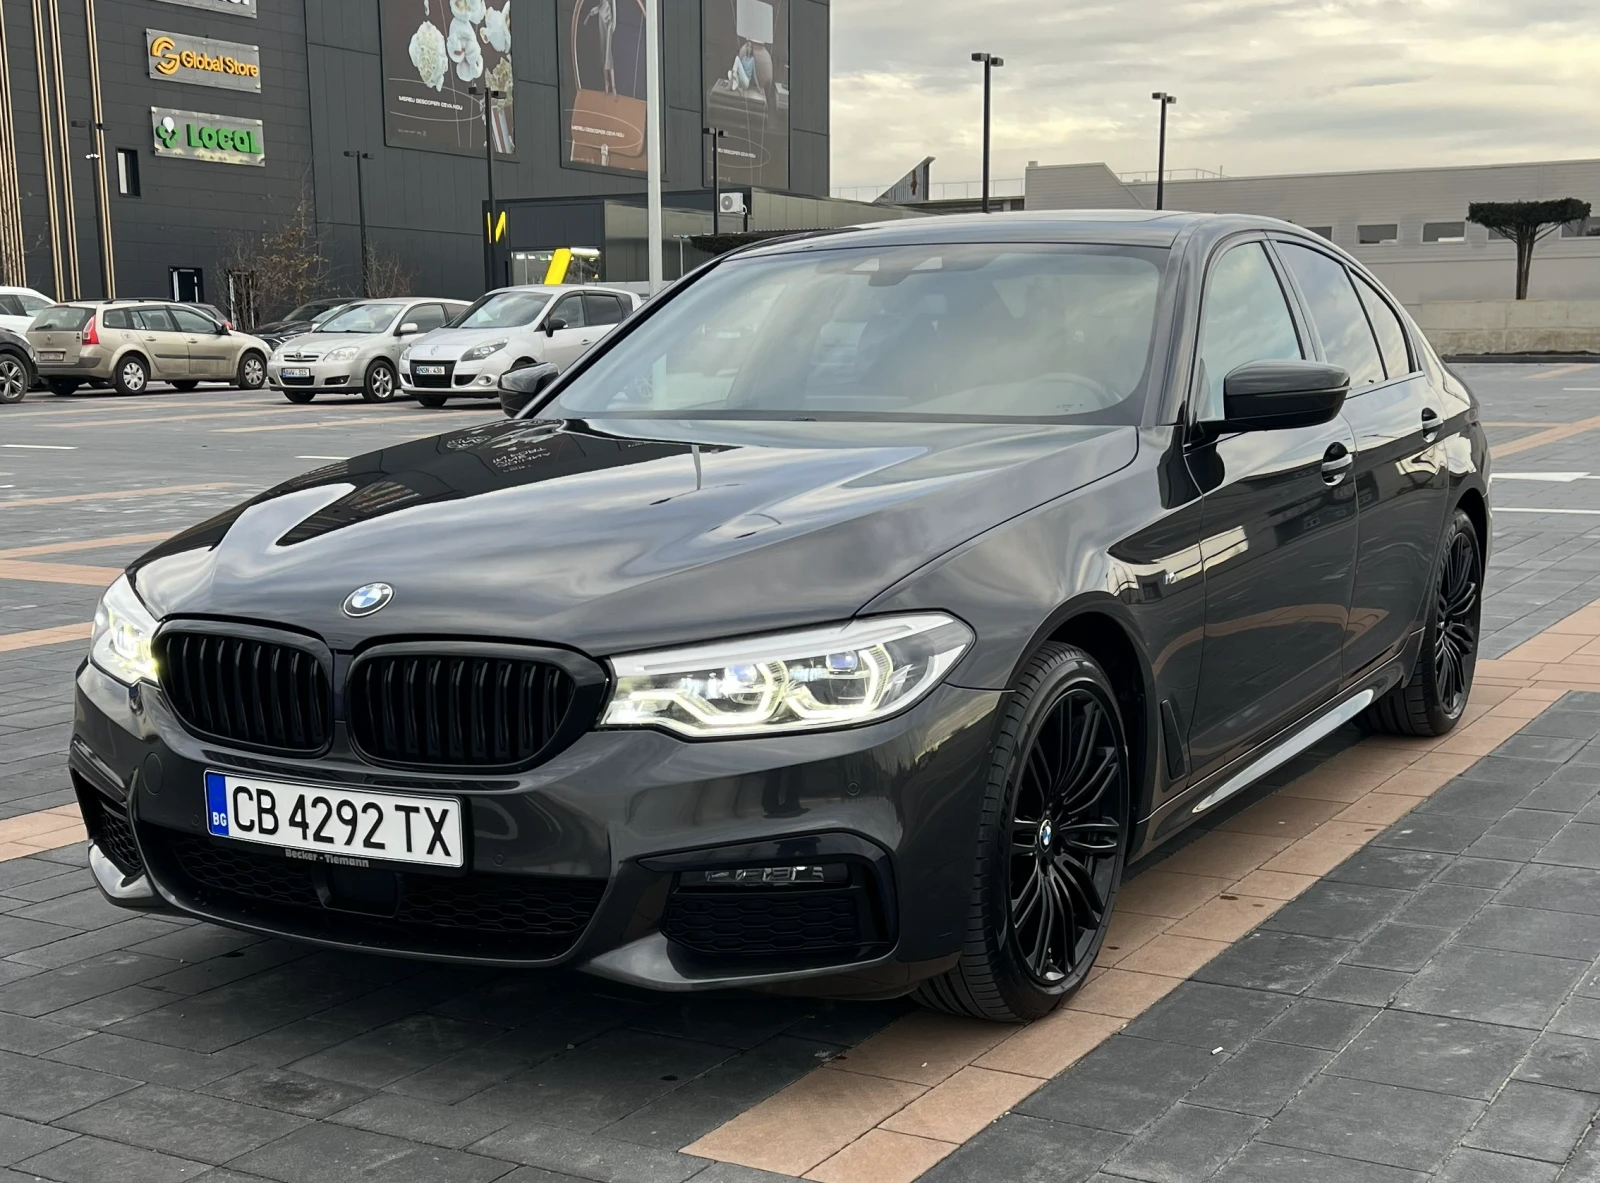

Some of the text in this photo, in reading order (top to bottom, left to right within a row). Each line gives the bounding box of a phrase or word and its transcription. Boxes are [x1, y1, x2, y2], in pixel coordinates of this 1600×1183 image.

[180, 50, 259, 77] Global Store
[212, 811, 227, 827] BG
[232, 785, 452, 857] CB 4292 TX
[284, 848, 318, 861] Becker
[324, 854, 370, 868] Tiemann
